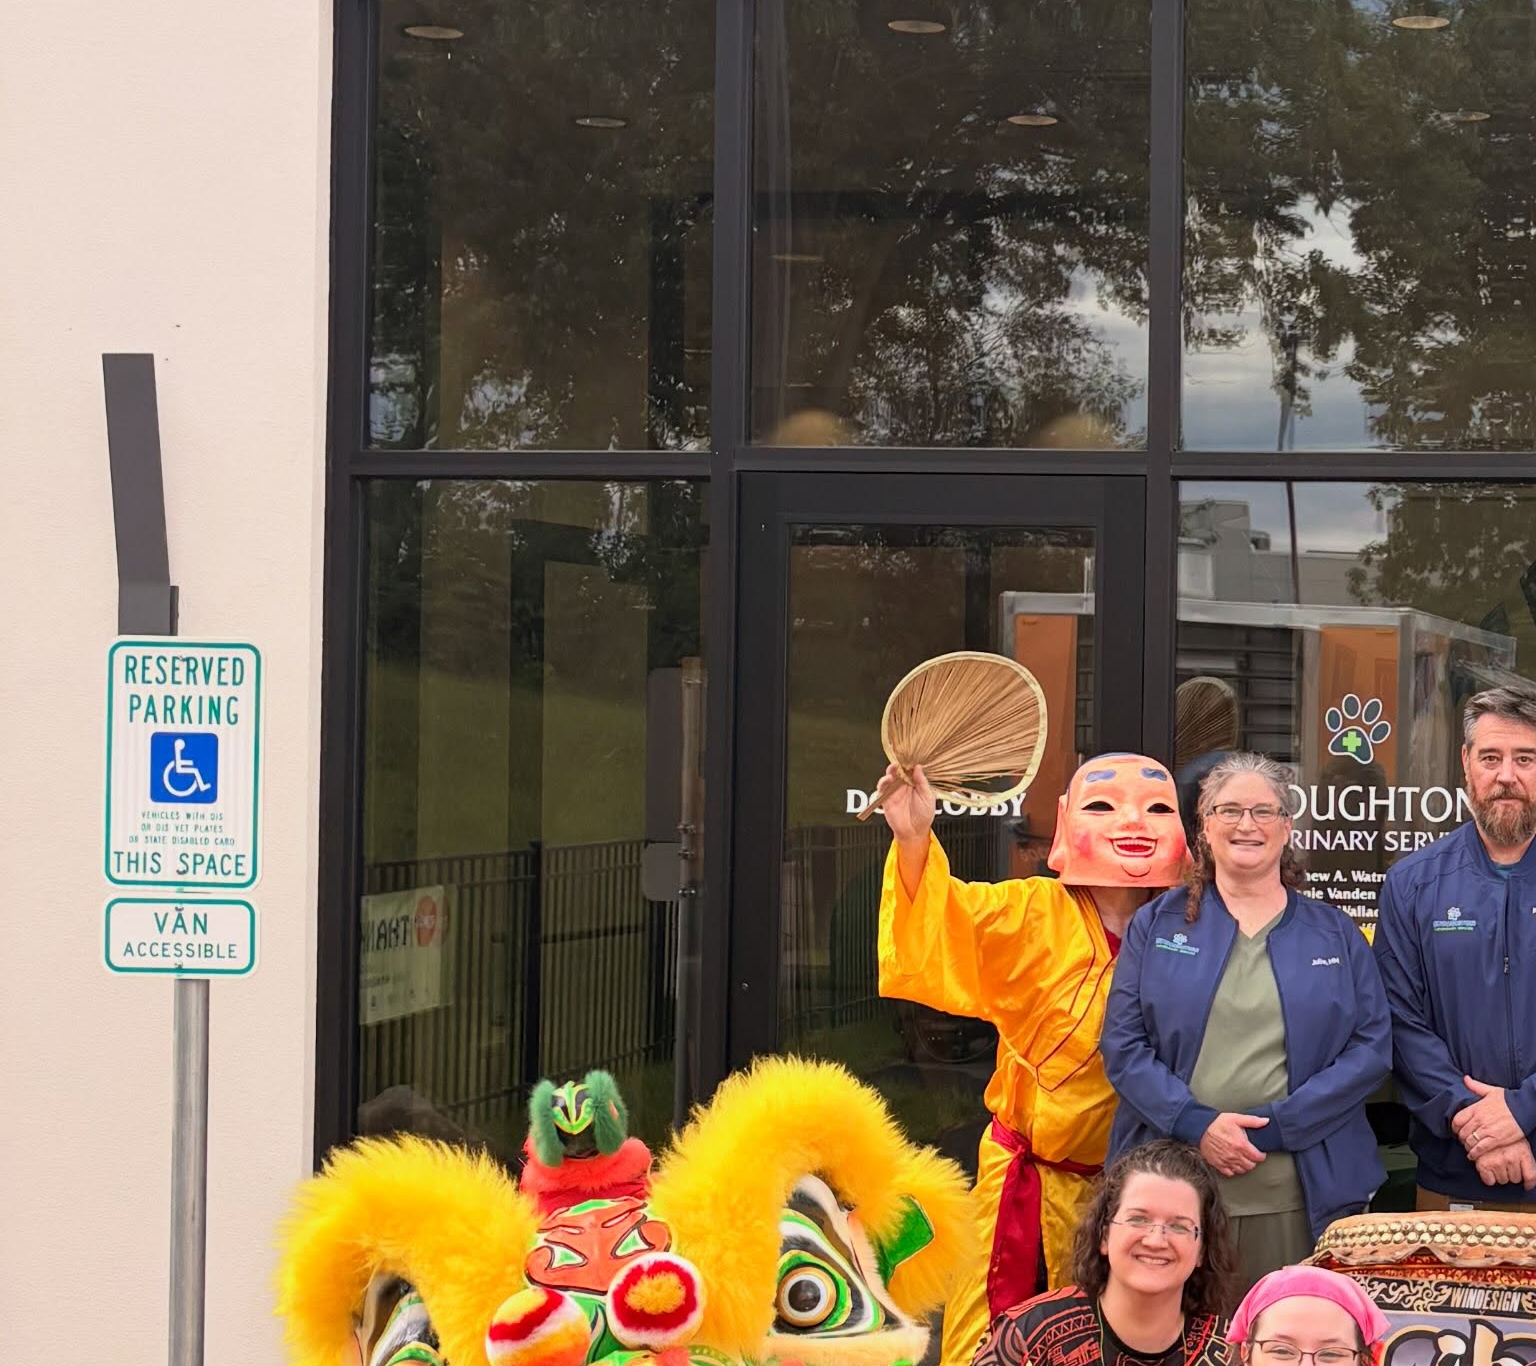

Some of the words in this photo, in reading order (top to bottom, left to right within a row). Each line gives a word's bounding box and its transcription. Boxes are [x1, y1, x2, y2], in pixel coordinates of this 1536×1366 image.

[125, 655, 245, 686] RESERVED
[129, 694, 239, 725] PARKING
[1288, 785, 1476, 823] OUGHTON
[141, 811, 180, 820] VEHICLES
[186, 812, 205, 820] WITH
[144, 835, 167, 844] STATE
[172, 836, 210, 845] DISABLED
[214, 837, 236, 846] CARD
[194, 825, 224, 834] PLATES
[1291, 829, 1378, 851] RINARY
[113, 851, 162, 874] THIS
[176, 853, 246, 876] SPACE
[1327, 887, 1377, 900] Vanden
[154, 912, 208, 935] VAN
[123, 941, 238, 959] ACCESSIBLE
[1450, 1285, 1522, 1313] WINDESIGN
